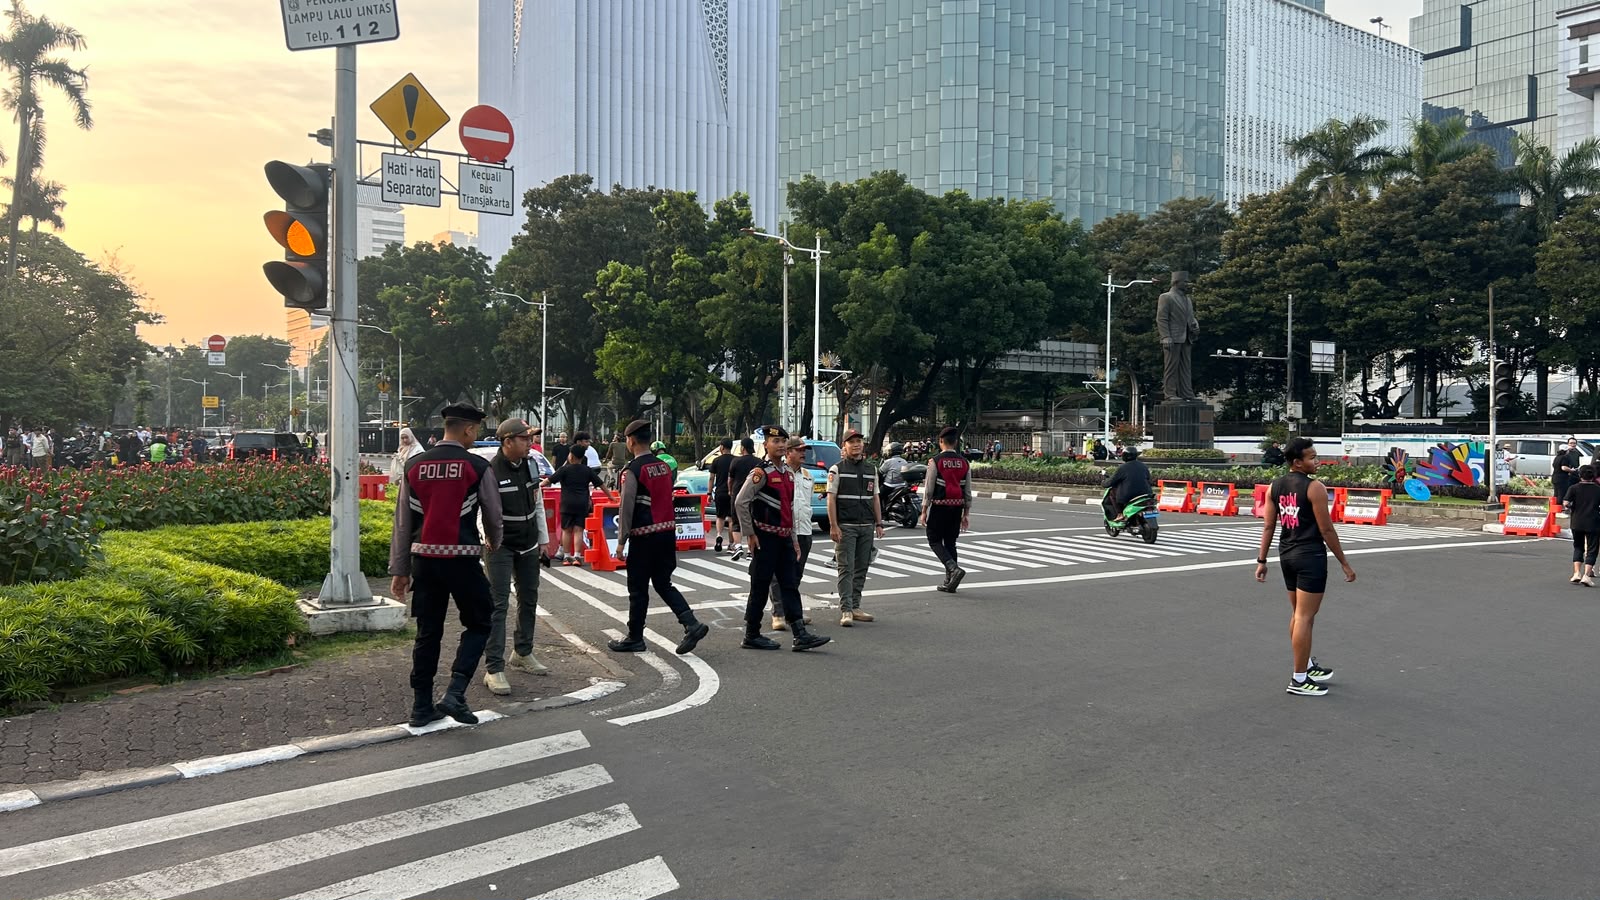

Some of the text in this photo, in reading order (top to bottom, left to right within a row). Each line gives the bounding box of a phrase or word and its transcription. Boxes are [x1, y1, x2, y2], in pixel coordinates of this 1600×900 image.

[288, 3, 392, 24] LAMPU LALU LINTAS
[306, 31, 333, 43] Telp.
[387, 161, 407, 176] Hati
[416, 165, 436, 179] Hati
[471, 169, 502, 182] Kecuali
[386, 180, 436, 197] Separator
[479, 183, 493, 195] Bus
[462, 194, 510, 209] Transjakarta
[646, 464, 669, 477] POLISI
[943, 460, 963, 468] POLISI
[418, 463, 463, 480] POLISI
